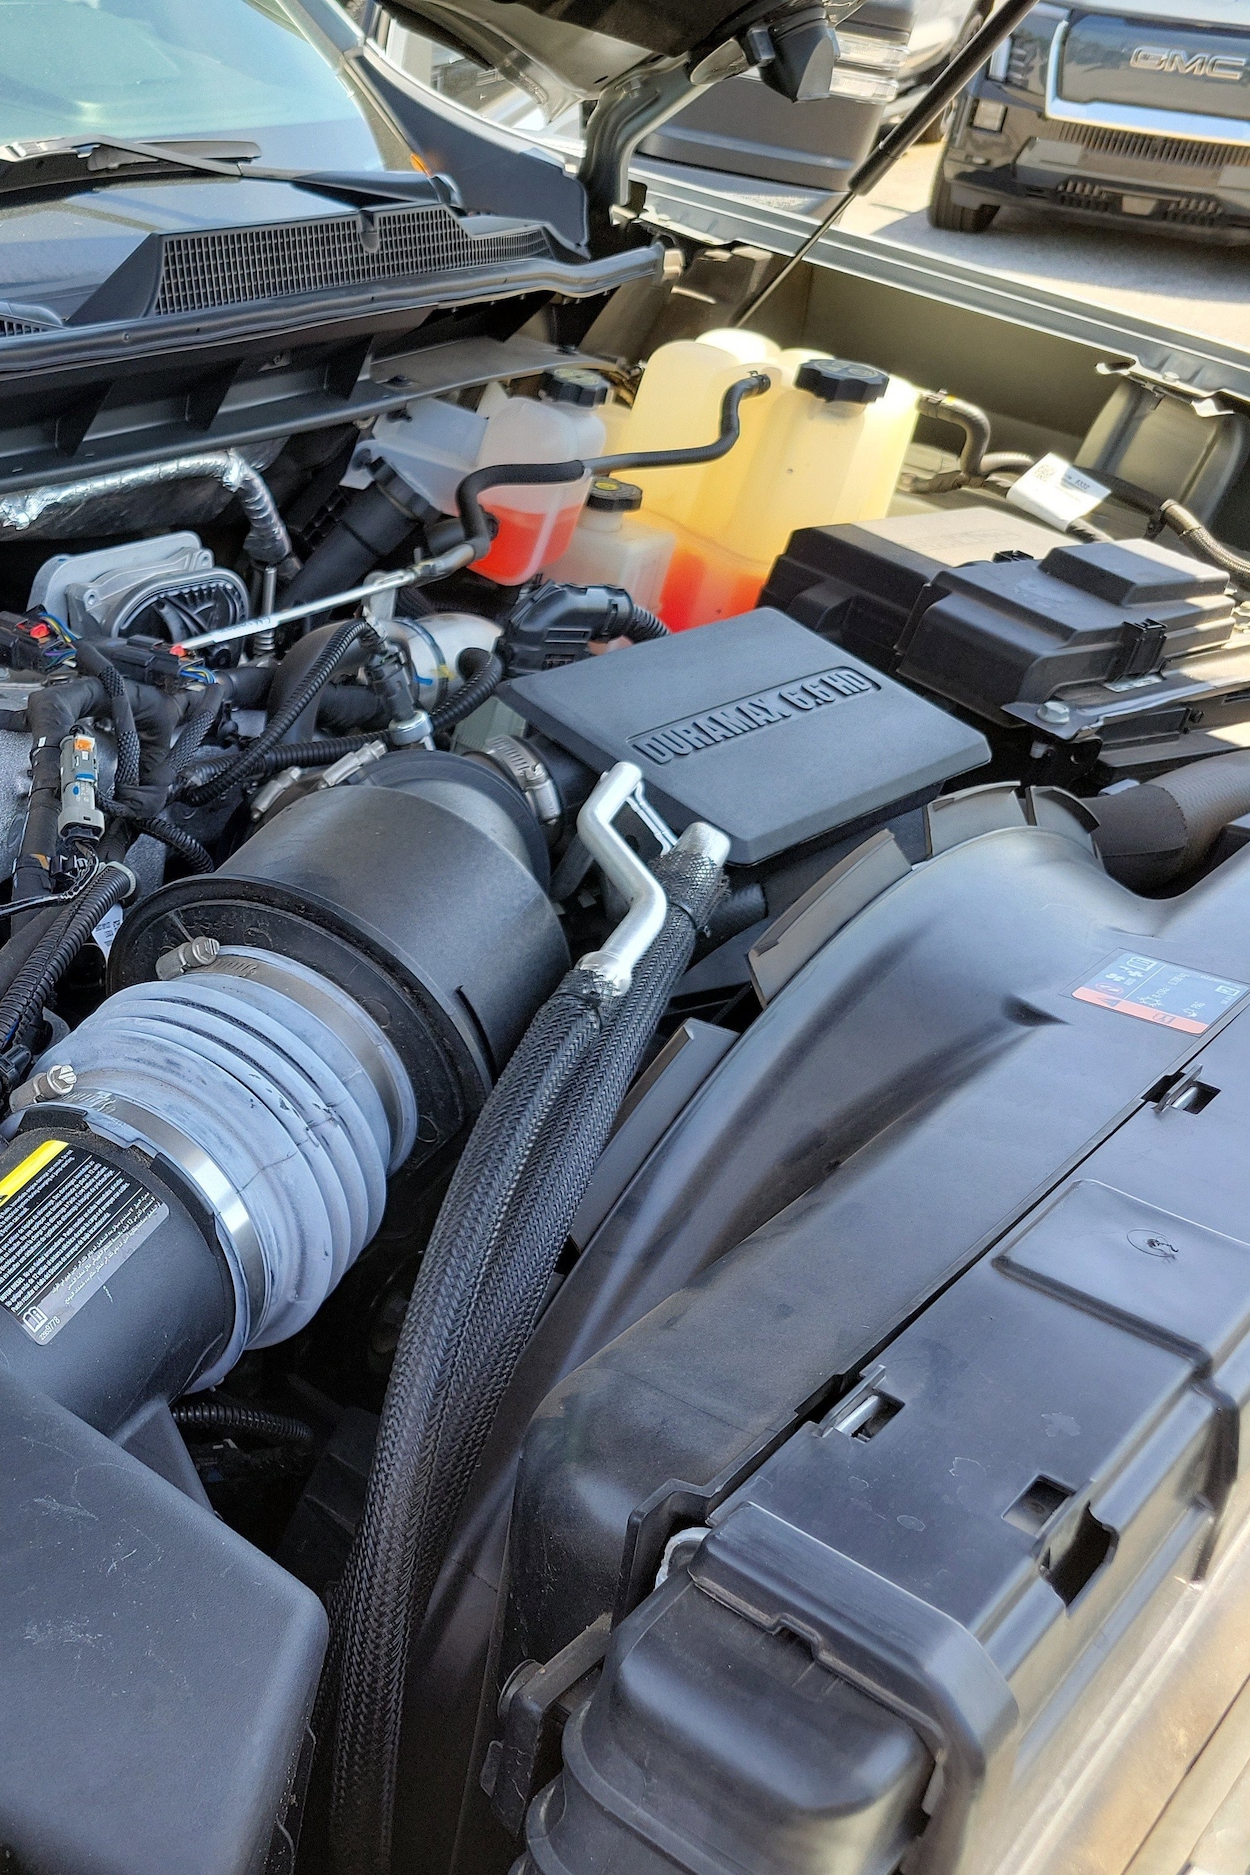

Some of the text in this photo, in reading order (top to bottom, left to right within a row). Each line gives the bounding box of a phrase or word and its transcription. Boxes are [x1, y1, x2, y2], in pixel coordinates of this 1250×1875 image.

[1129, 45, 1247, 80] GMC
[632, 670, 873, 765] DURAMAX 6.6 HD
